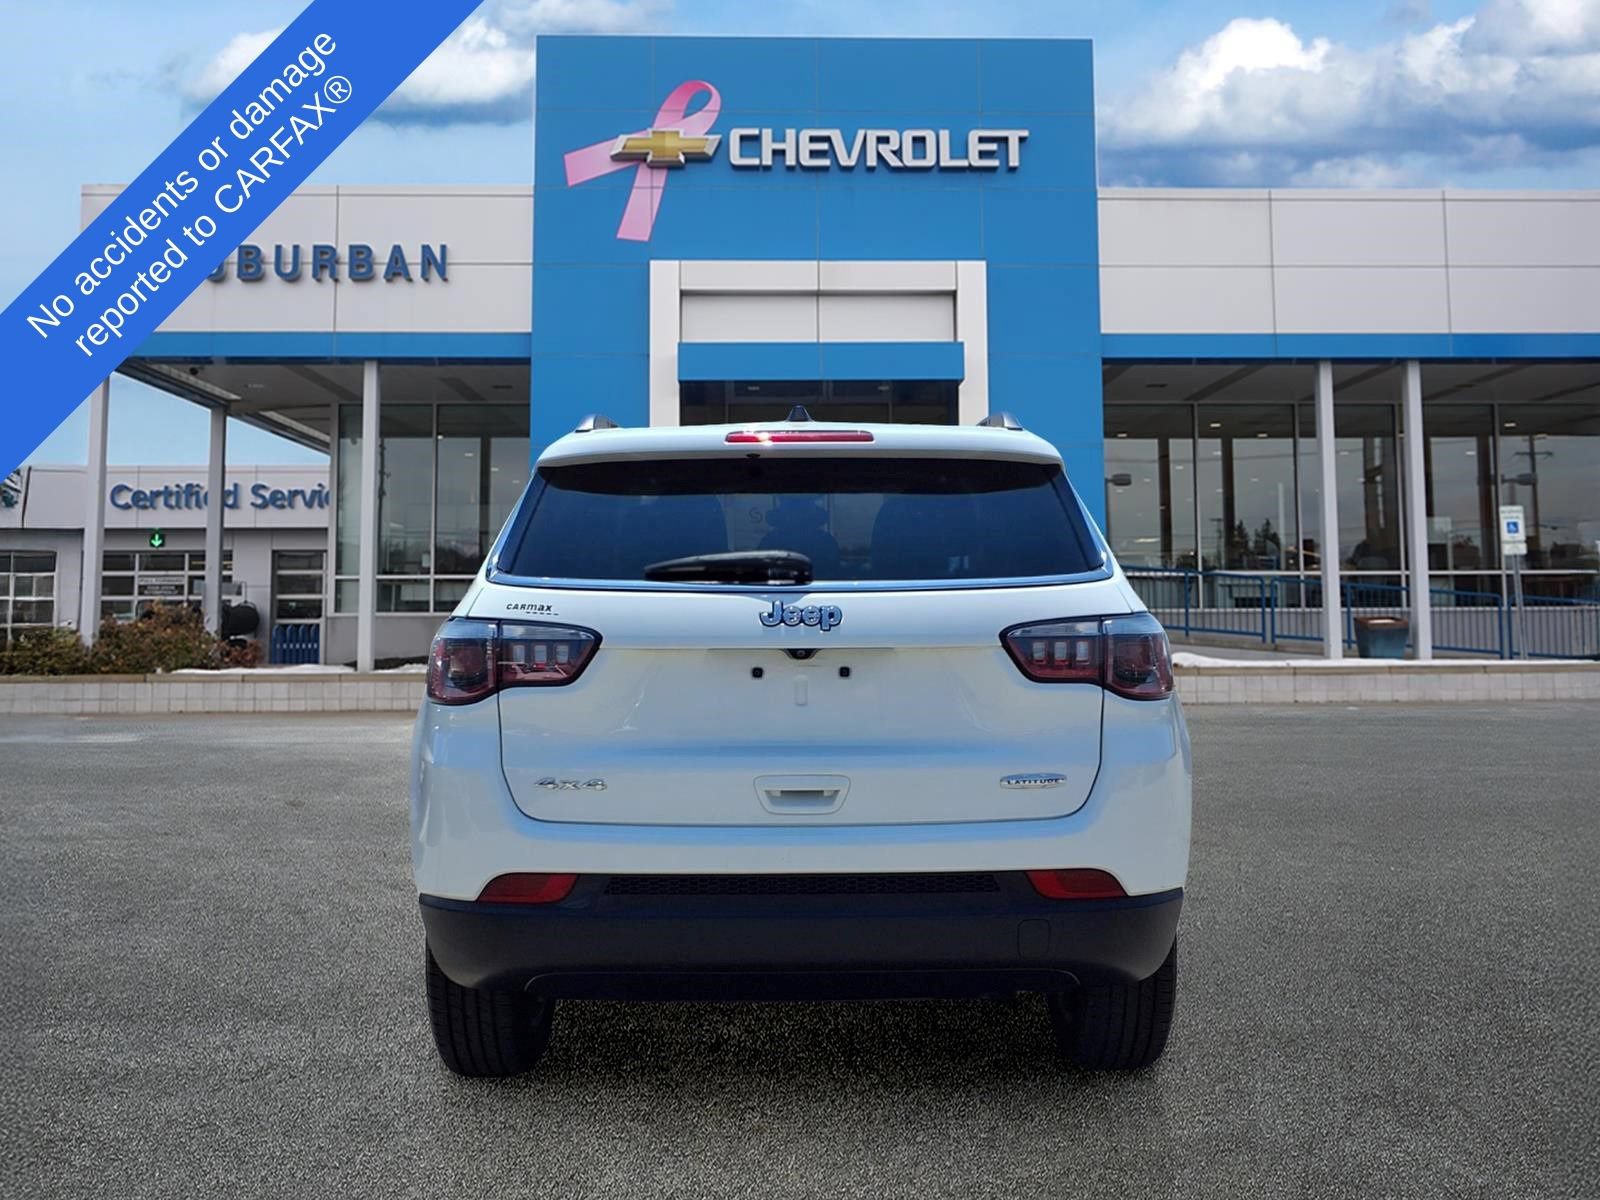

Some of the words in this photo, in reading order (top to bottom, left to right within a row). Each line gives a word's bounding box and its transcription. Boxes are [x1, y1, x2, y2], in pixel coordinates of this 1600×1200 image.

[729, 128, 1030, 168] CHEVROLET
[206, 244, 447, 282] BURBAN
[109, 483, 240, 510] Certifid
[759, 599, 843, 632] Jeep
